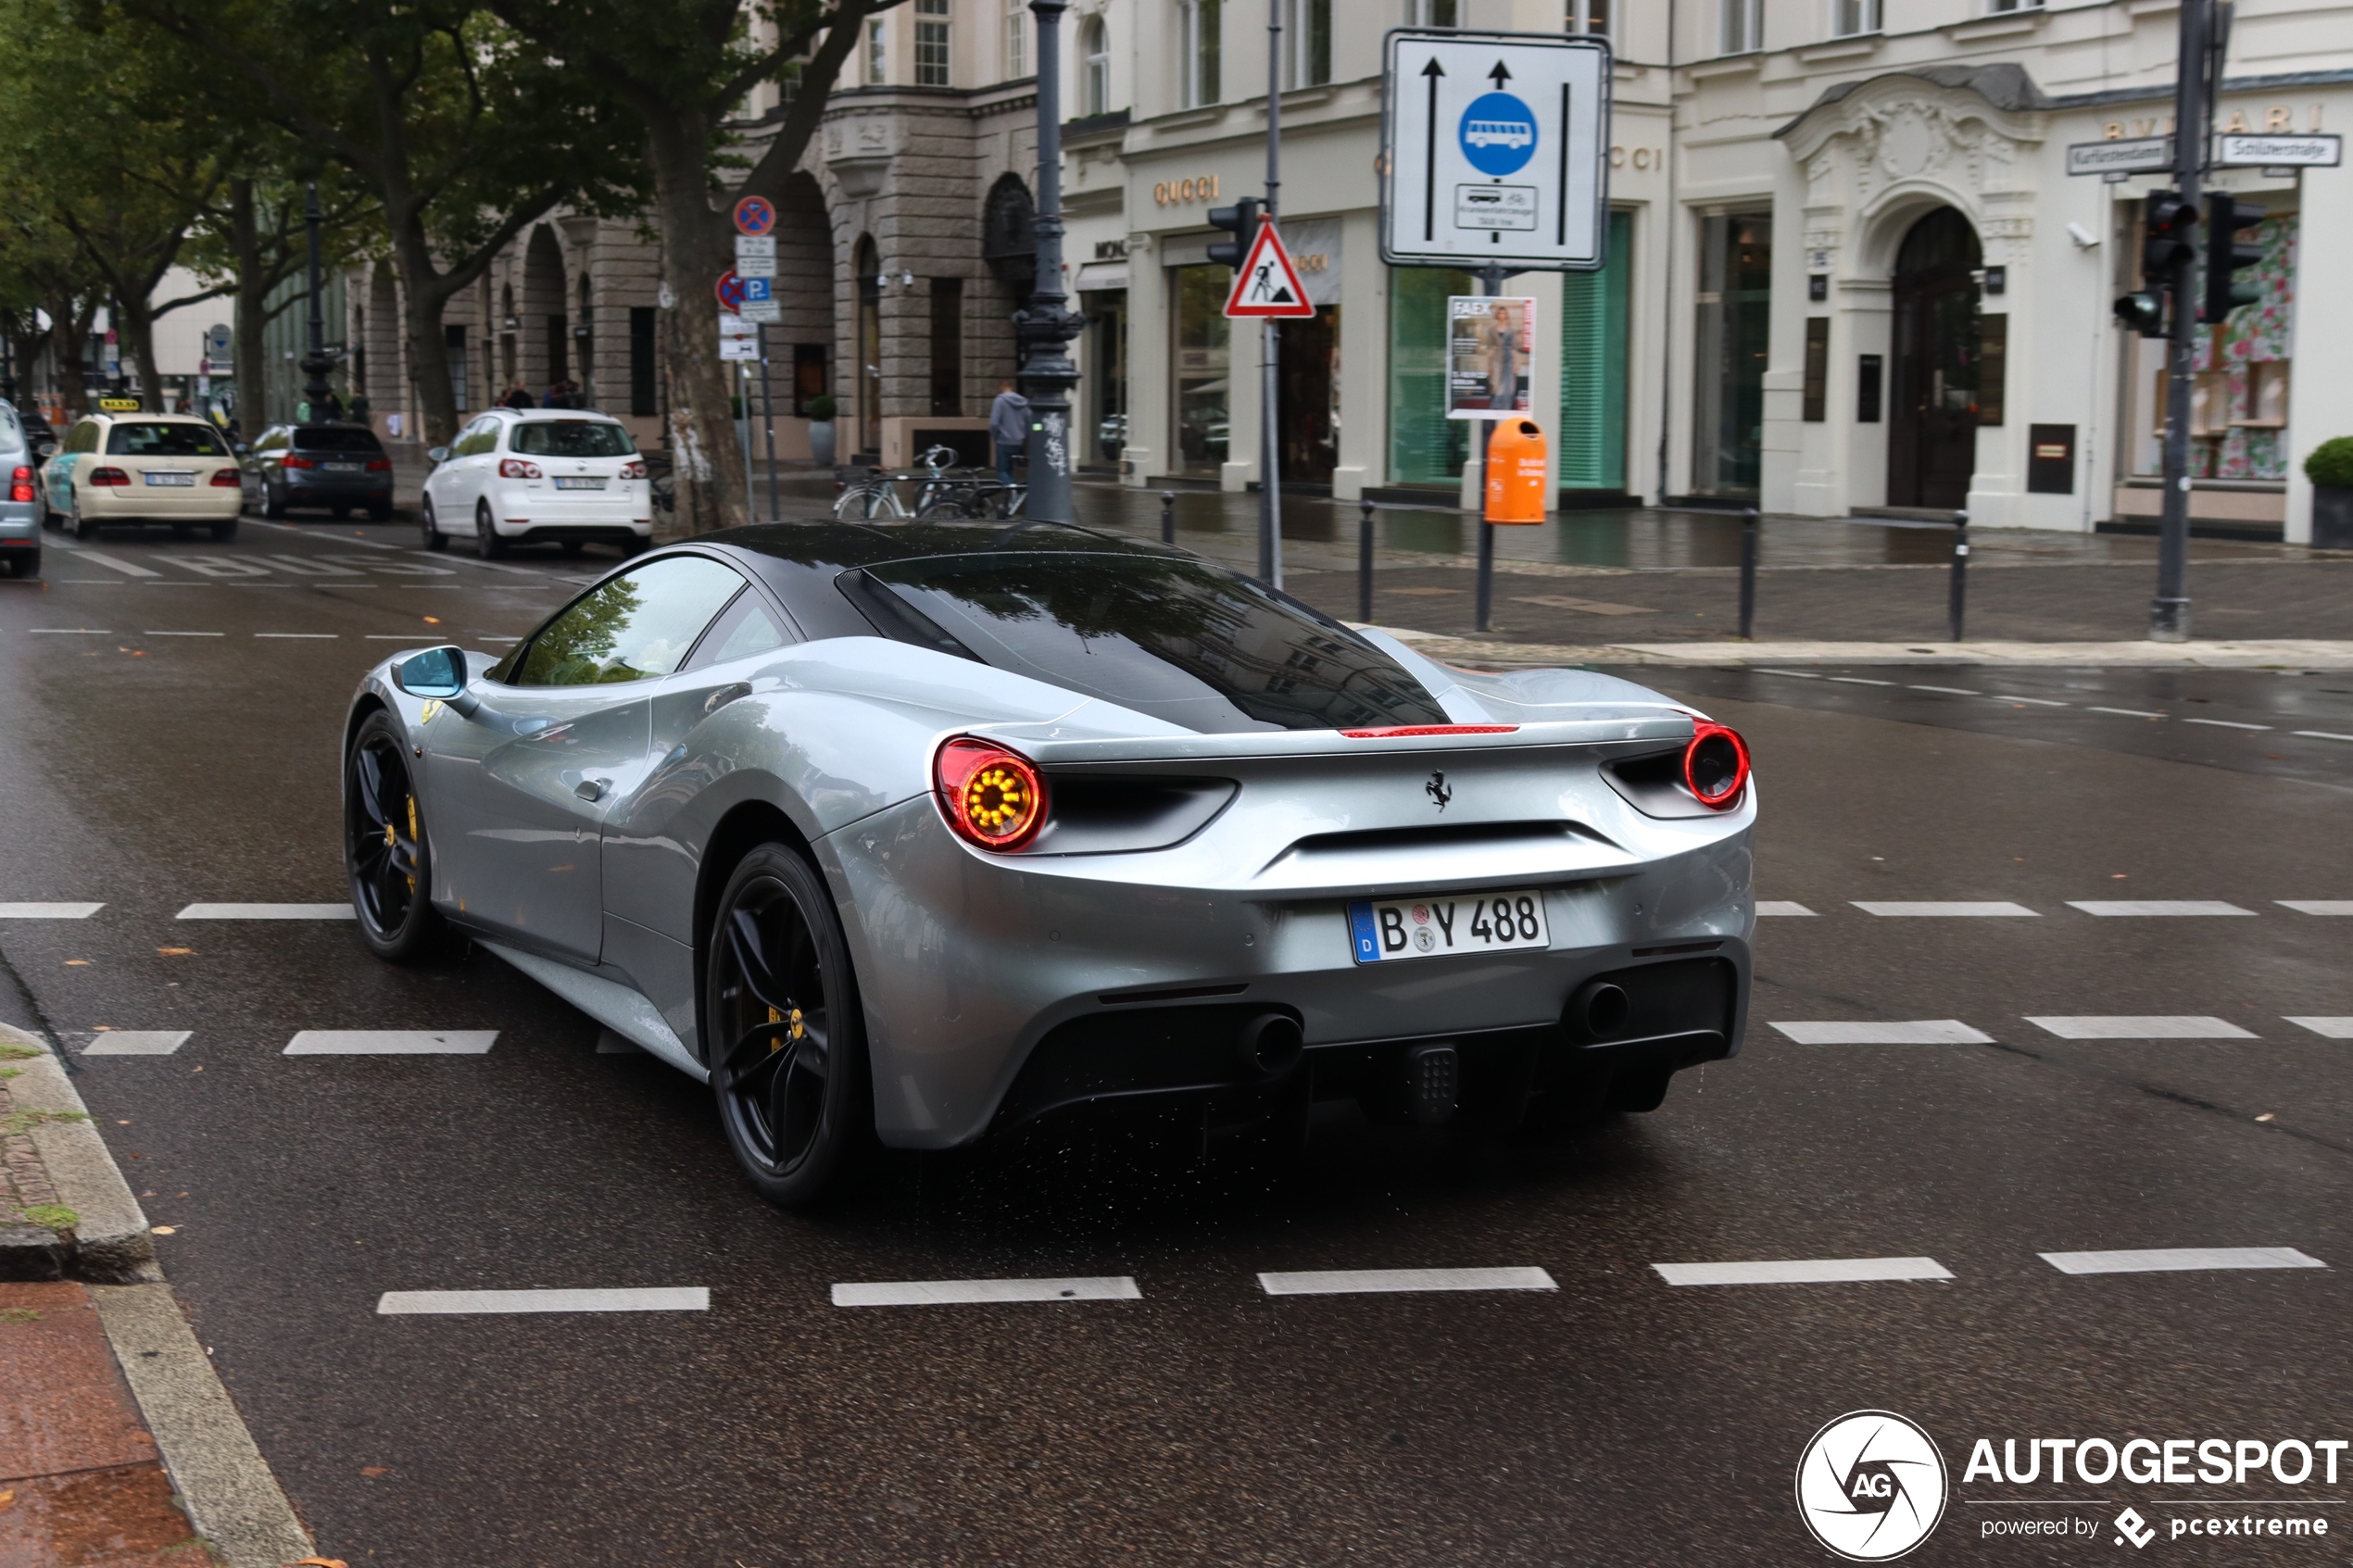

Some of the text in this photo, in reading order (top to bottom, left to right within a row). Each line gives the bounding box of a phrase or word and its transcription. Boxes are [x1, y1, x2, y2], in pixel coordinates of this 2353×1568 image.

[2103, 103, 2323, 140] BVARI
[1609, 145, 1663, 171] CCI
[1154, 174, 1220, 206] GUCCI
[749, 280, 763, 299] P
[1378, 896, 1540, 953] B Y 488
[1361, 938, 1373, 953] D
